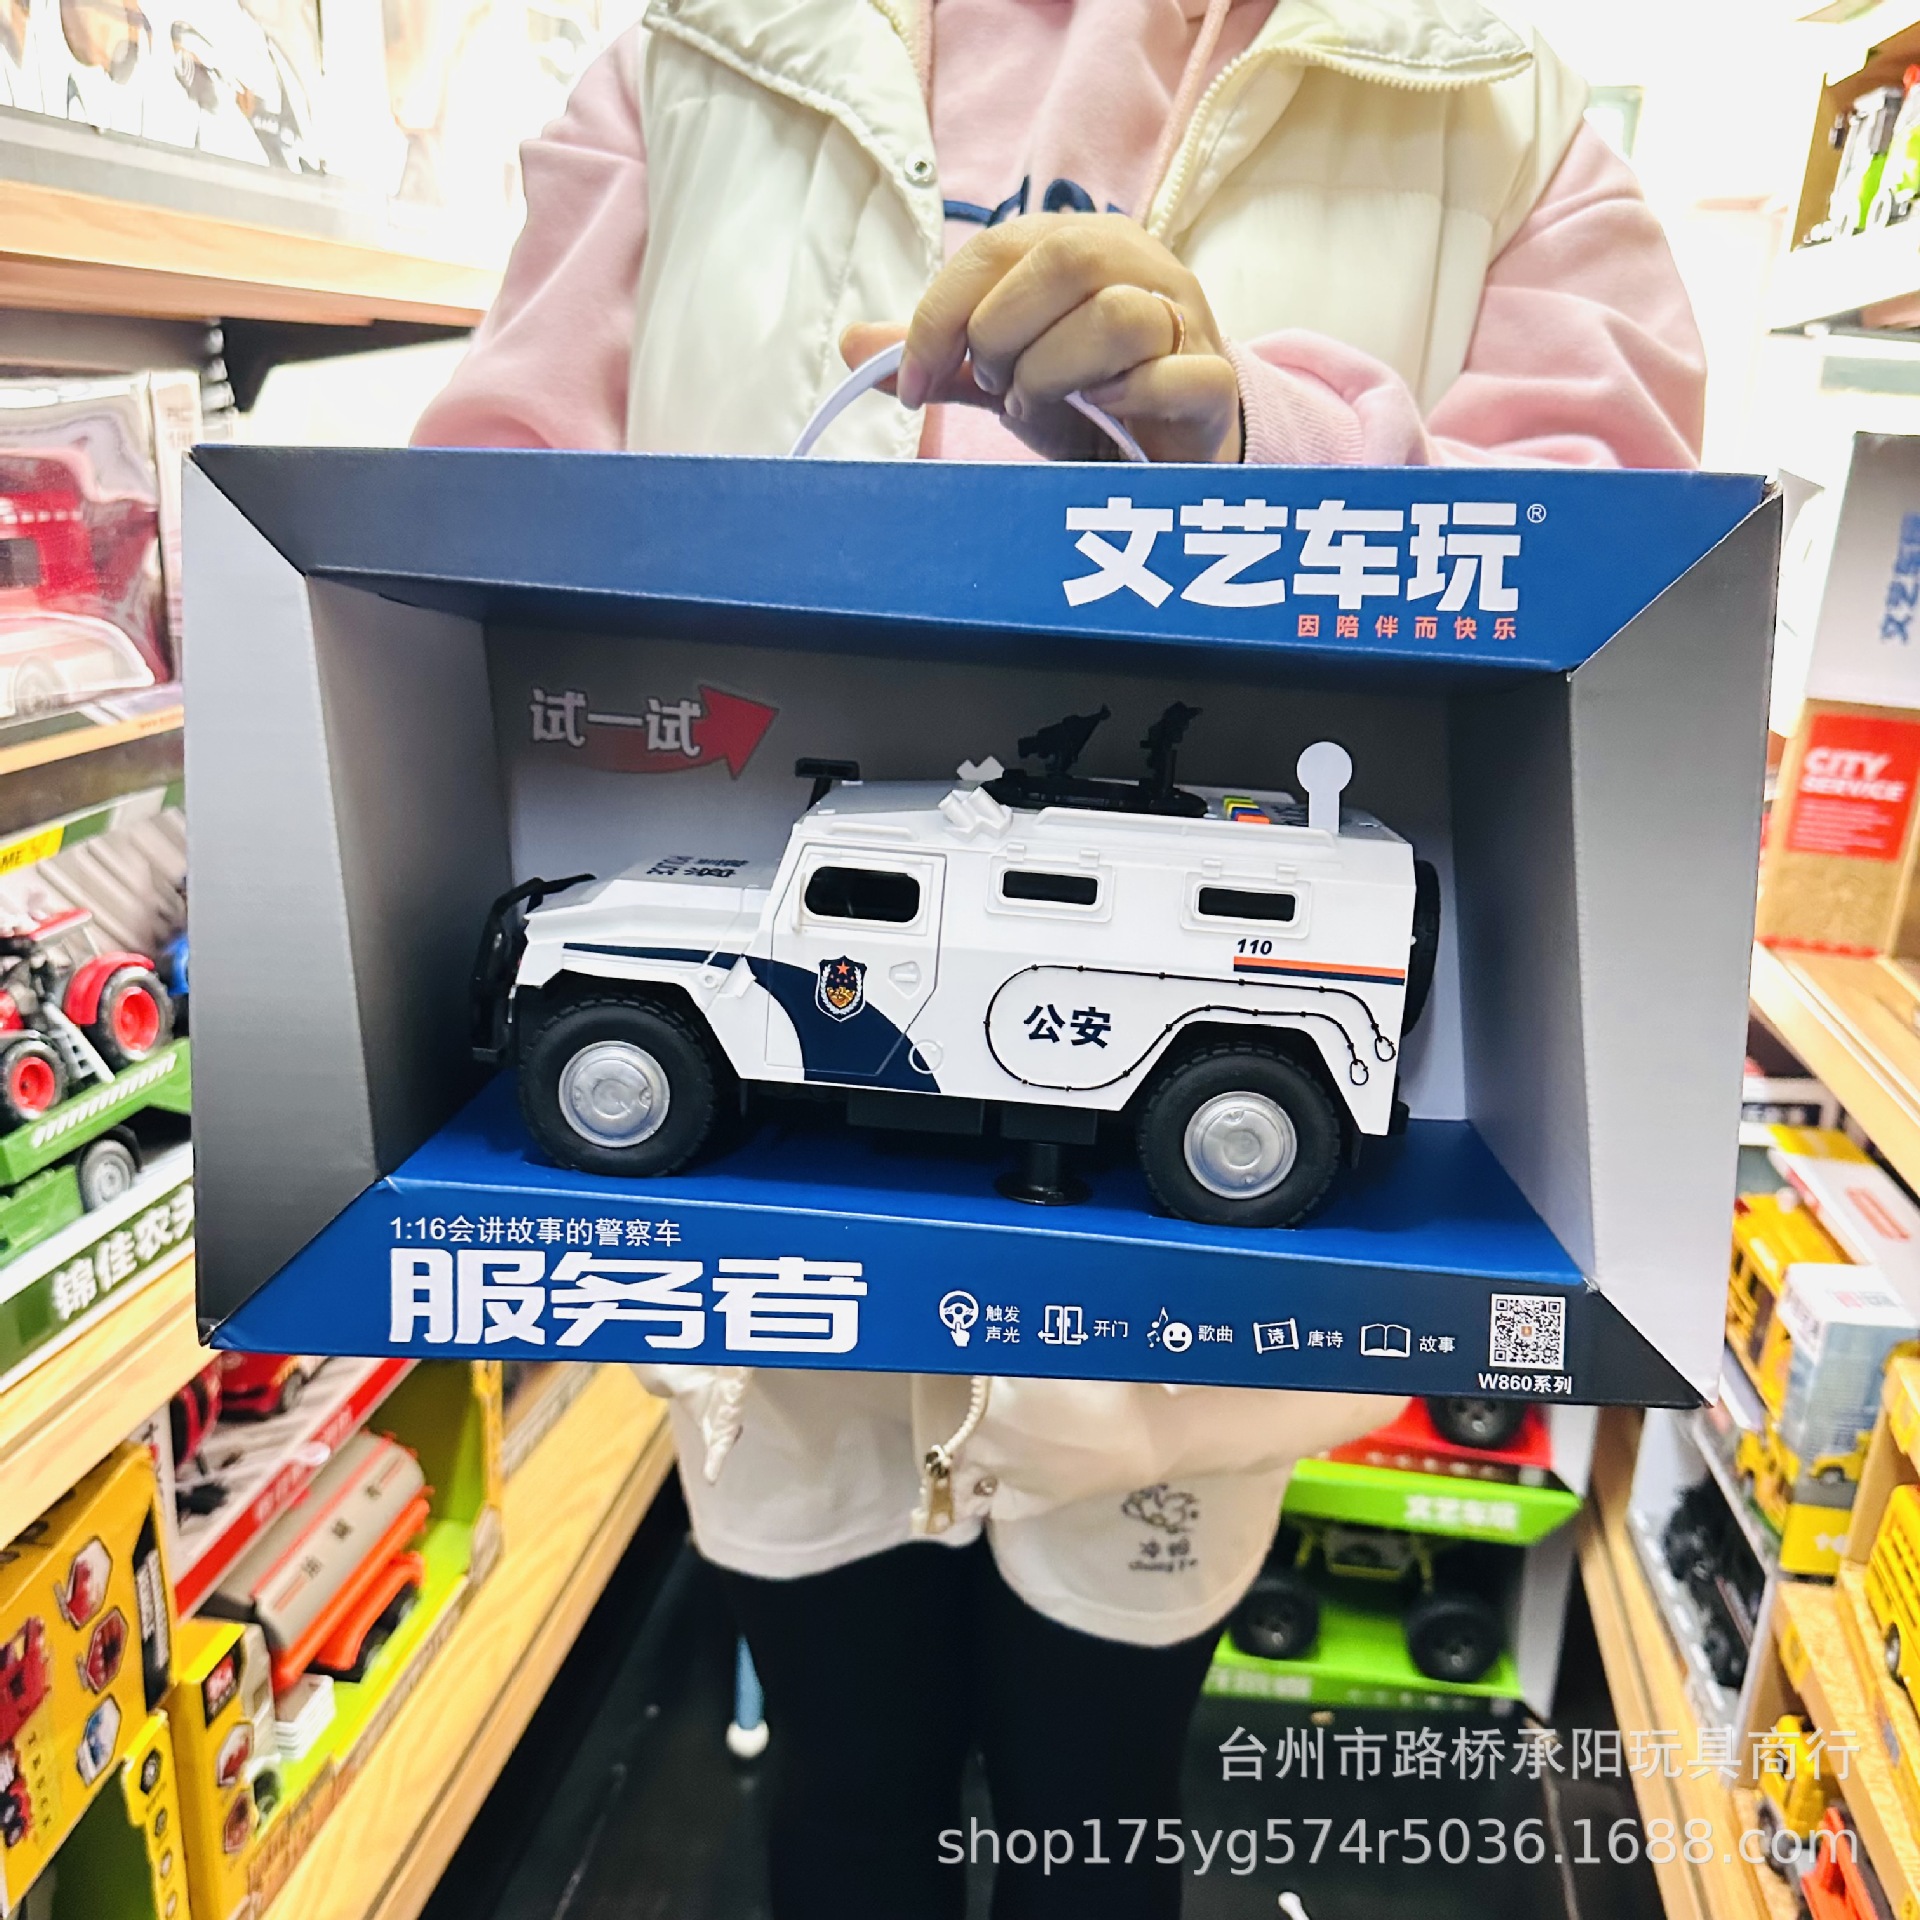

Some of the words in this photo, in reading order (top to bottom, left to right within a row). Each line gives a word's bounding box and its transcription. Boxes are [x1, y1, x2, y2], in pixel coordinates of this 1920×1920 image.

[1063, 497, 1521, 612] 文艺车玩
[1297, 614, 1517, 641] 因陪伴而快乐
[530, 688, 701, 757] 试一试
[1806, 746, 1891, 780] CITY
[1237, 938, 1273, 956] 110
[1023, 1003, 1112, 1049] 公安
[389, 1216, 682, 1247] 1:16会讲故事的警察车
[389, 1247, 868, 1354] 服务者
[985, 1304, 1021, 1324] 触发
[985, 1326, 1021, 1344] 声光
[1093, 1320, 1129, 1339] 开门
[1197, 1324, 1234, 1344] 歌曲
[1267, 1327, 1286, 1346] 诗
[1307, 1329, 1344, 1349] 唐诗
[1418, 1335, 1456, 1354] 故事
[1478, 1372, 1573, 1396] W860系列
